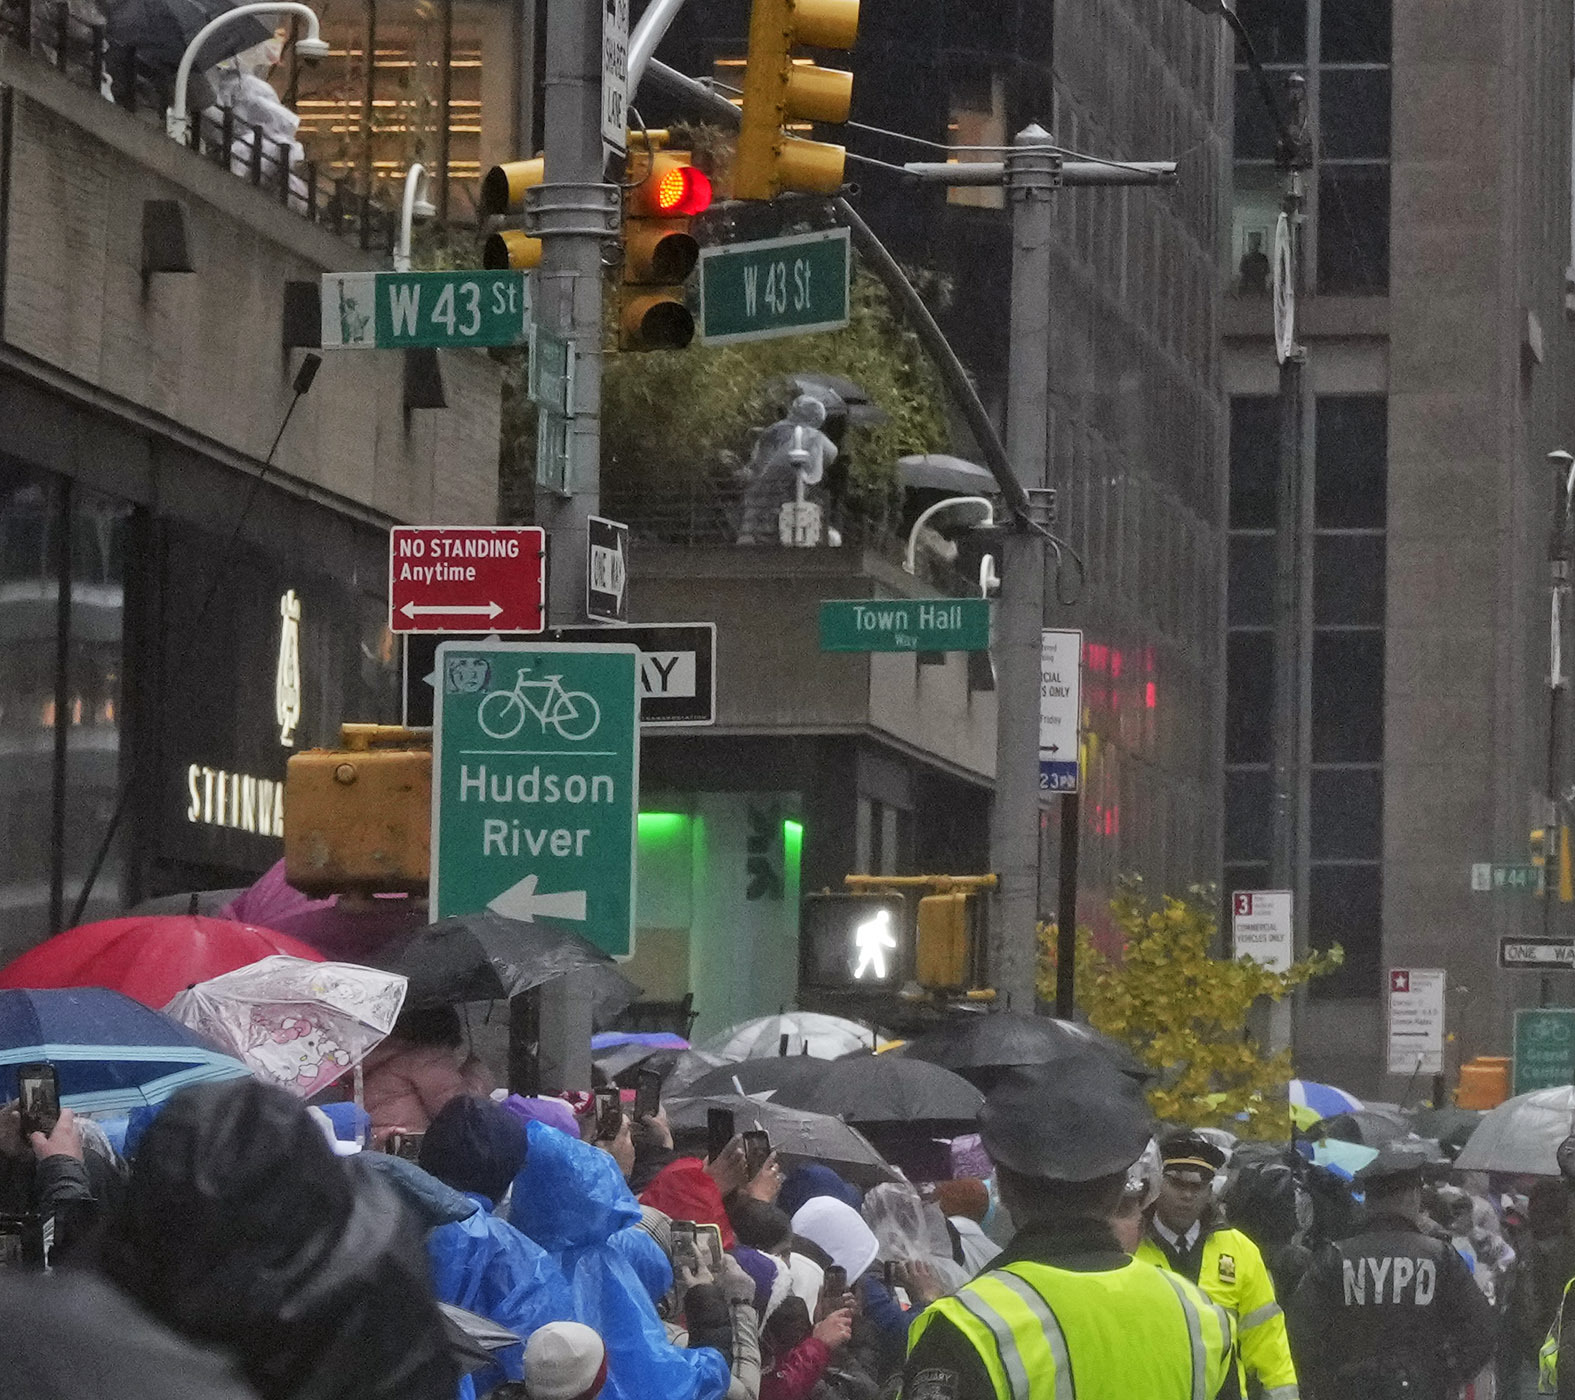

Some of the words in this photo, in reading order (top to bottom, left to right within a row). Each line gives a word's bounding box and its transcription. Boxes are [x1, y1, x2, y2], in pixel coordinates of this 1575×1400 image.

[744, 265, 758, 317] W
[765, 262, 788, 314] 43
[794, 258, 812, 310] St
[389, 284, 420, 337] W
[430, 281, 481, 337] 43
[491, 280, 517, 314] St
[400, 538, 425, 558] NO
[430, 538, 520, 559] STANDING
[400, 562, 476, 585] Anytime
[853, 605, 909, 631] Town
[919, 605, 962, 631] Hall
[895, 632, 918, 649] Way
[1049, 685, 1070, 698] ONLY
[459, 764, 615, 804] Hudson
[187, 763, 285, 838] STEINWA
[483, 818, 591, 857] River
[1238, 894, 1249, 915] 3
[1507, 946, 1537, 960] ONE
[1342, 1257, 1437, 1306] NYPD
